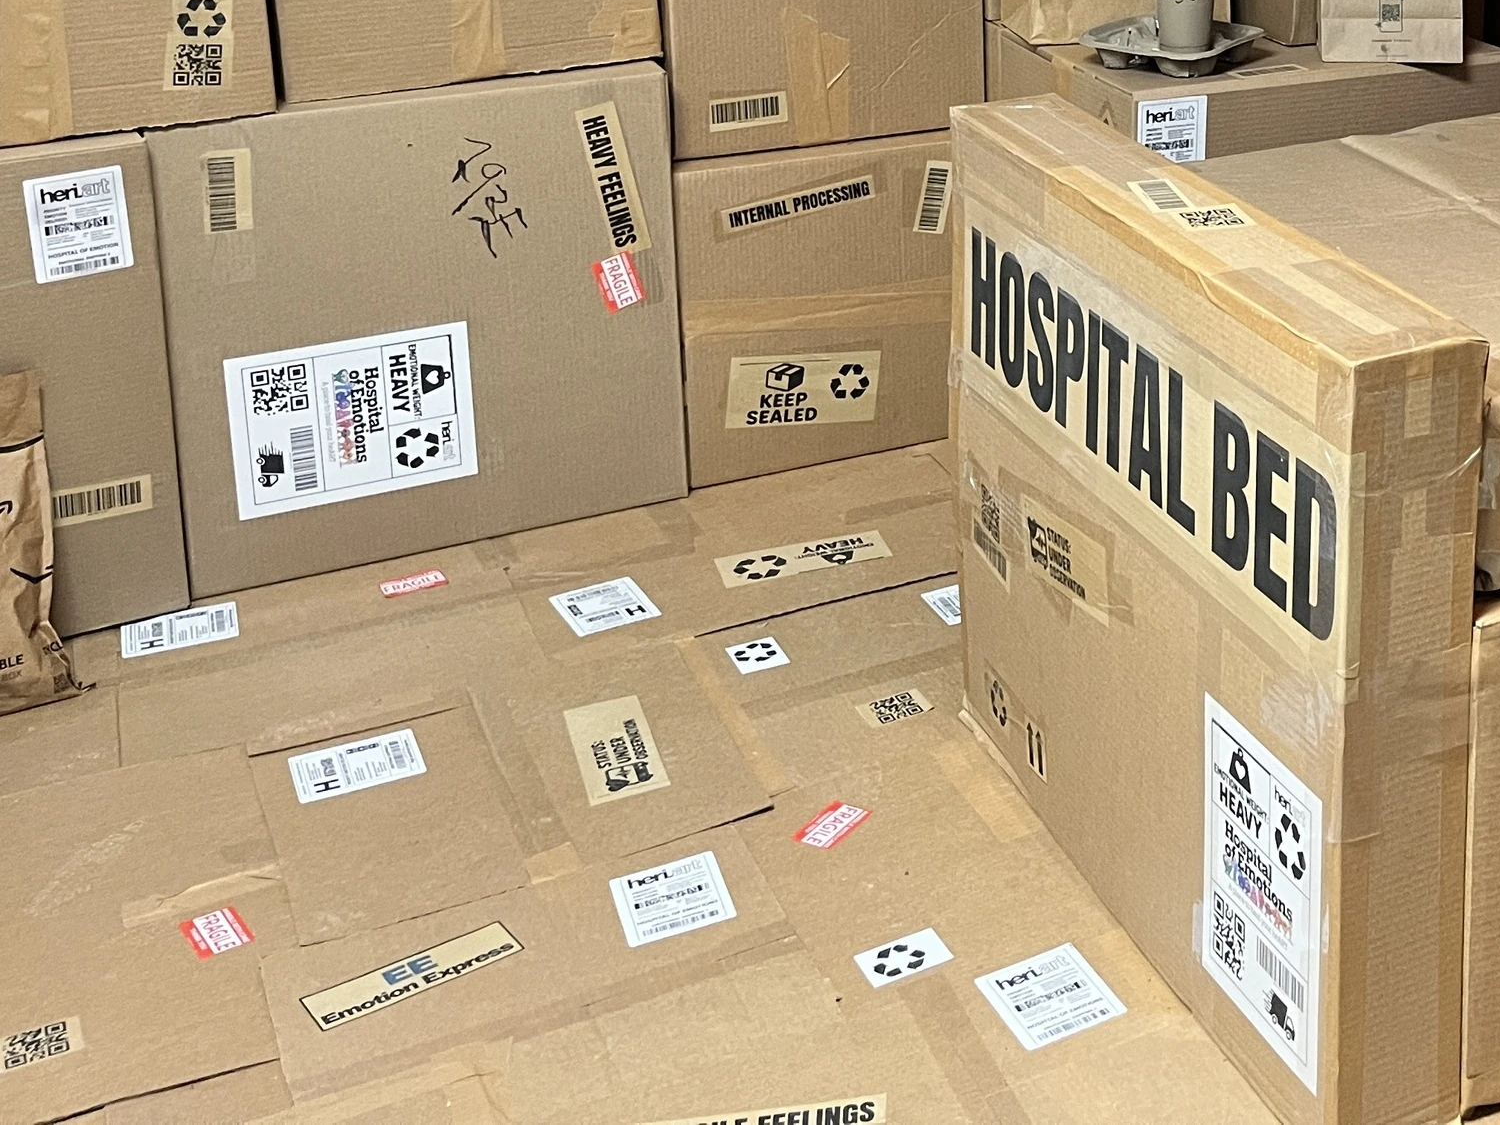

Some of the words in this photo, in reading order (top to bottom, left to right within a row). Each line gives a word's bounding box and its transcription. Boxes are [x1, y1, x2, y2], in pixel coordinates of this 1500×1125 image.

[1145, 106, 1195, 125] heri.art
[582, 115, 617, 170] HEAVY
[40, 177, 110, 205] heri.art
[597, 169, 637, 249] FEELINGS
[728, 199, 790, 229] INTERNAL
[792, 180, 871, 214] PROCESSING
[604, 256, 634, 309] FRAGILE
[389, 354, 411, 413] HEAVY
[407, 342, 419, 387] EMOTIONAL
[364, 365, 385, 434] Hospital
[412, 386, 422, 420] WEIGHT:
[746, 406, 818, 425] SEALED
[759, 391, 808, 410] KEEP
[352, 383, 369, 464] Emotions
[970, 225, 1196, 535] HOSPITAL
[1211, 398, 1338, 641] BED
[802, 537, 865, 555] HEAVY
[1046, 526, 1072, 555] STATUS:
[1048, 551, 1072, 576] UNDER
[1048, 570, 1087, 601] OBSERVATION
[625, 605, 647, 616] H
[141, 637, 164, 650] H
[590, 738, 613, 770] STATUS:
[609, 735, 632, 765] UNDER
[622, 718, 649, 761] OBSERVATION
[314, 778, 341, 794] H
[1213, 762, 1247, 804] EMOTIONAL
[1243, 792, 1270, 826] WEIGHT:
[806, 806, 858, 847] FRAGILE
[1218, 781, 1264, 841] HEAVY
[1224, 818, 1273, 878] Hospital
[1237, 845, 1293, 923] Emotions
[202, 913, 237, 952] FRAGILE
[320, 981, 420, 1026] Emotion
[421, 940, 516, 986] Express
[381, 954, 439, 986] EE
